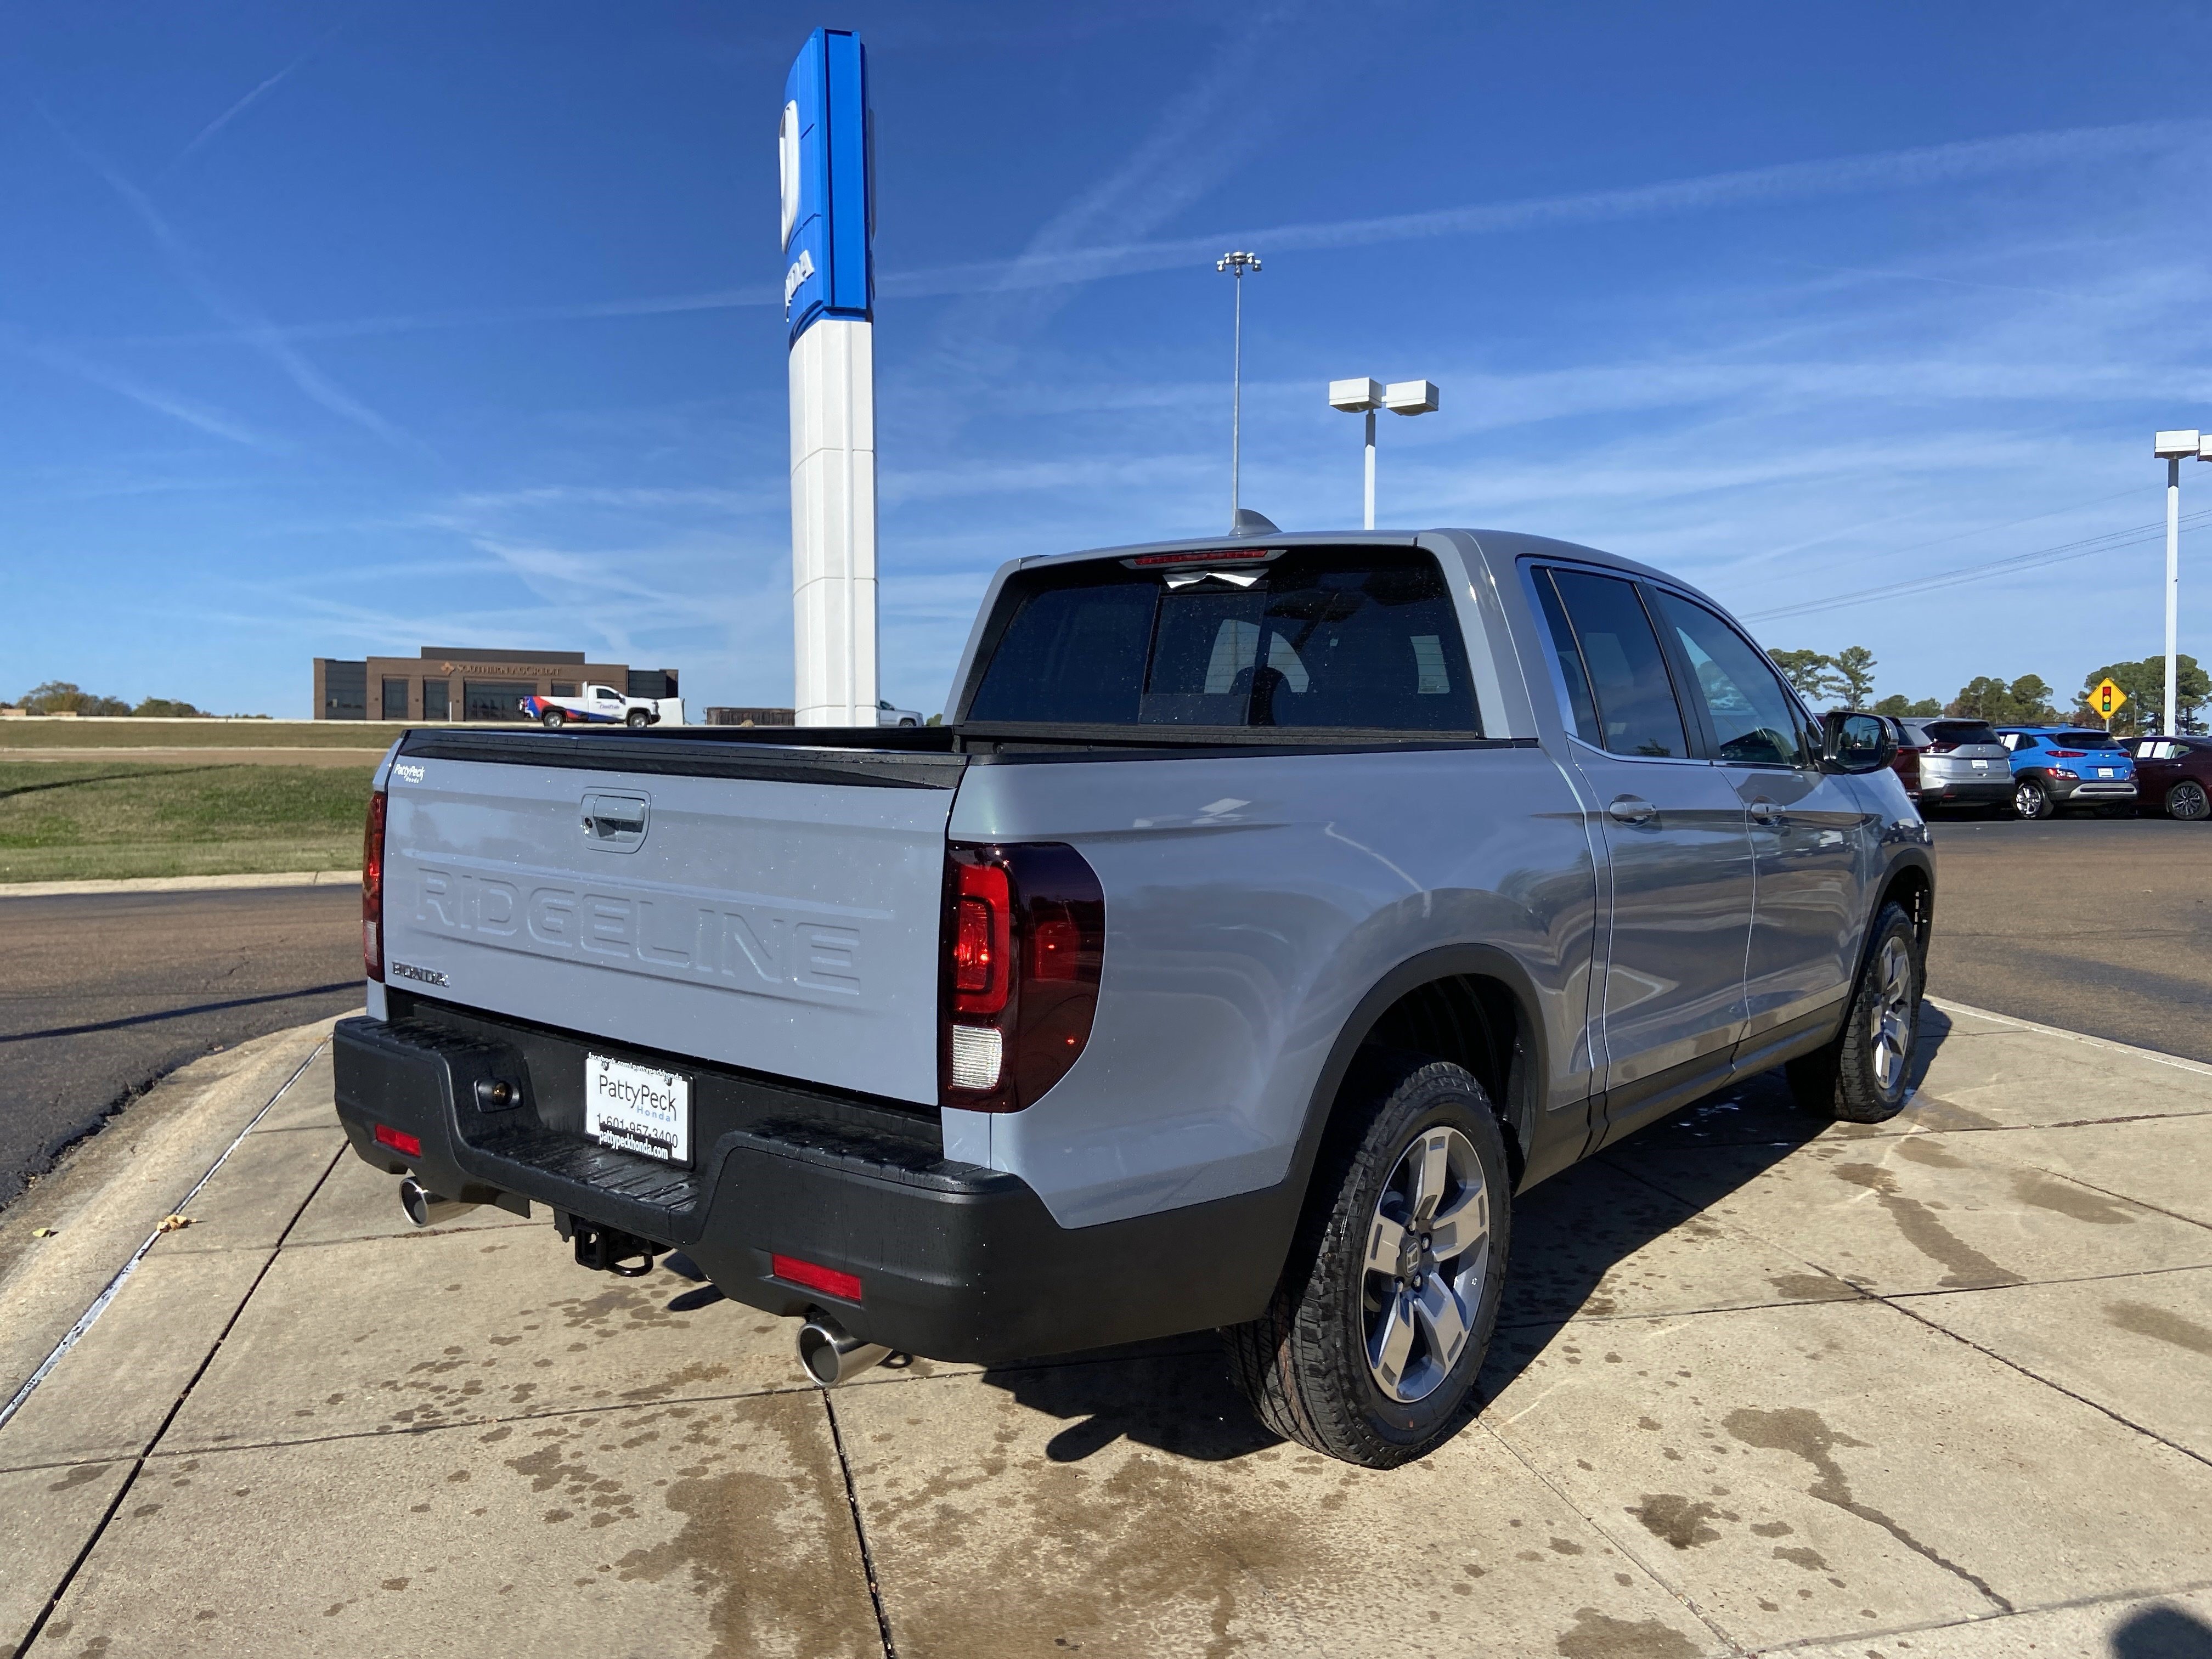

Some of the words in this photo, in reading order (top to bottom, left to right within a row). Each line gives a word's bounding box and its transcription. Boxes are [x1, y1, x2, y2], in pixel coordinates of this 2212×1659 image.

[416, 868, 860, 995] RIDGELINE
[392, 961, 450, 988] HONDA
[589, 1052, 682, 1081] facebook.com/pattypeckhonda
[599, 1074, 676, 1121] PattyPeck
[637, 1105, 670, 1122] Honda
[599, 1130, 668, 1160] pattypeckhonda.com
